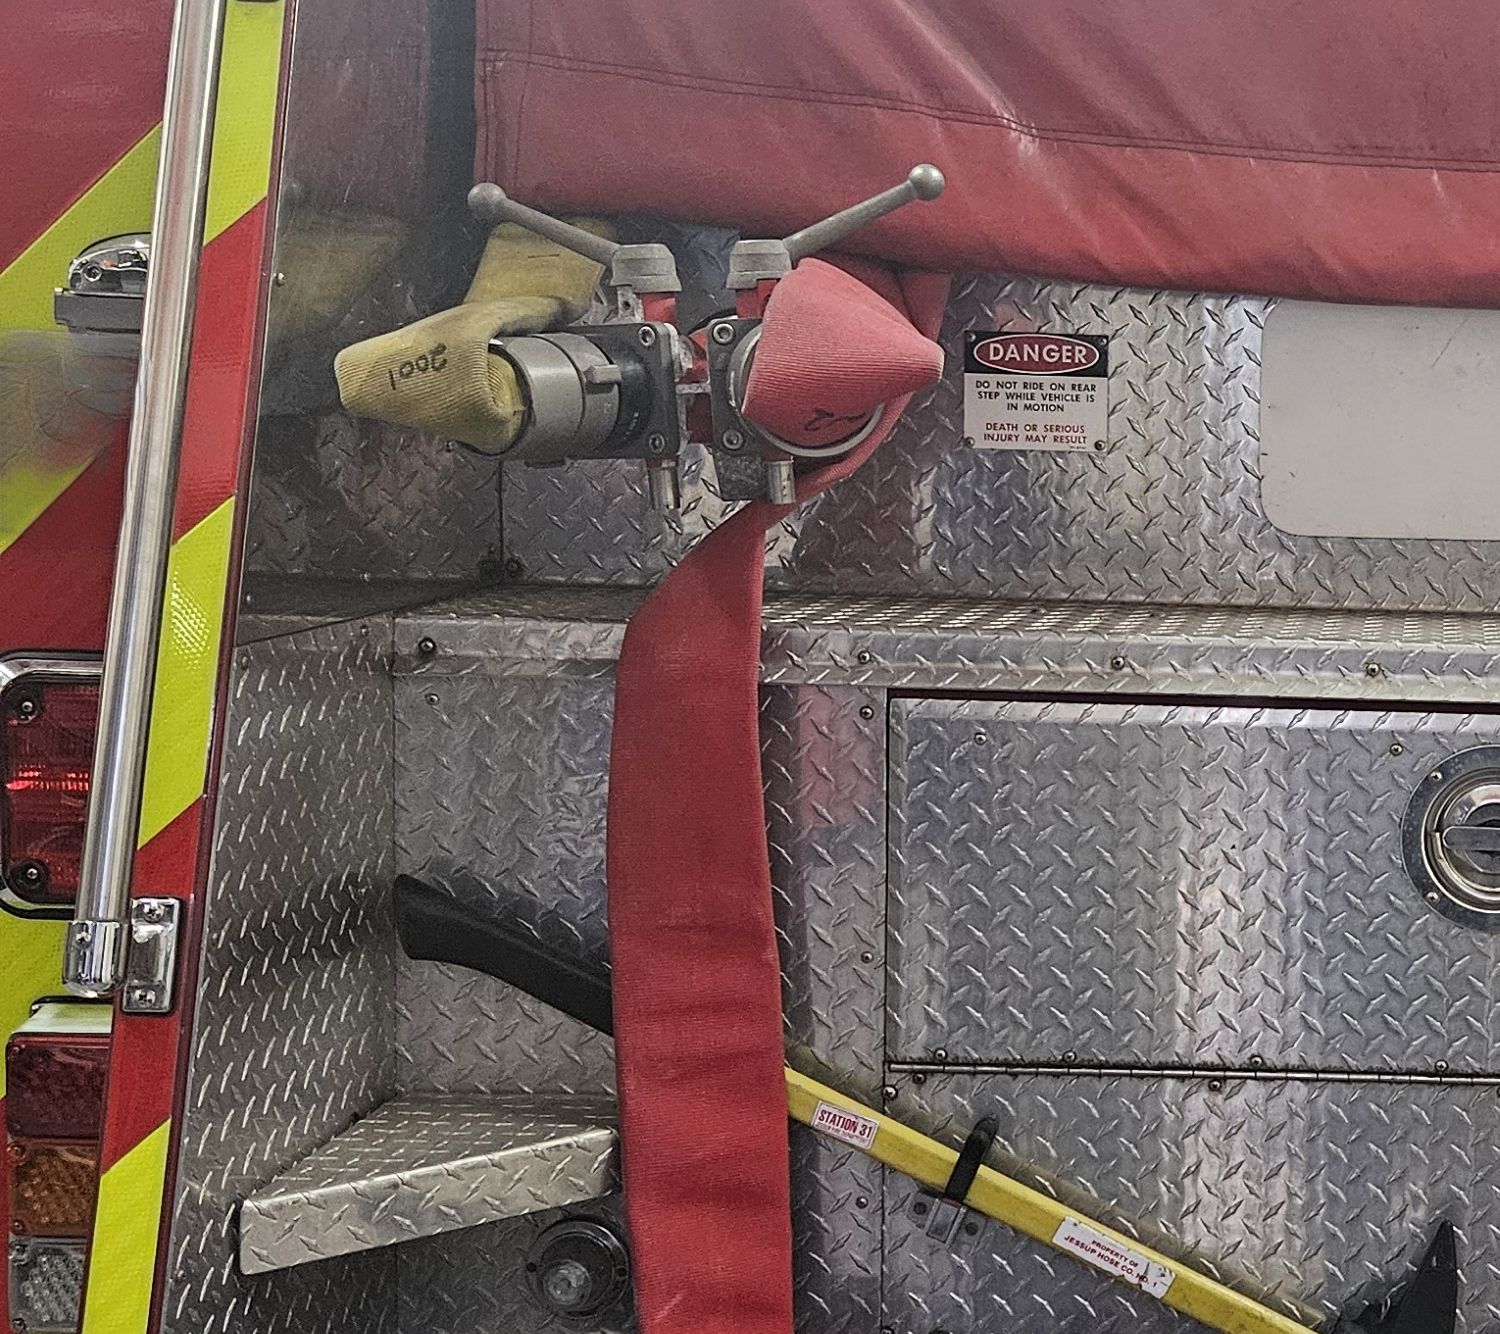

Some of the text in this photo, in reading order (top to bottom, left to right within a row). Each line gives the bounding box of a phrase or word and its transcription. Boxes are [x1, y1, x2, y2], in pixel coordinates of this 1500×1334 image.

[989, 343, 1087, 364] DANGER
[975, 380, 1097, 393] DO NOT RIDE ON REAR
[978, 391, 1095, 403] STEP WHILE VEHICLE IS
[1007, 403, 1065, 412] IN MOTION
[985, 422, 1085, 434] DEATH OR SERIOUS
[983, 433, 1087, 444] INJURY MAY RESULT
[818, 1109, 859, 1134] STATION
[859, 1124, 873, 1138] 31
[1064, 1234, 1097, 1255] JESSUP
[1097, 1251, 1119, 1267] HOSE
[1091, 1239, 1139, 1268] PROPERTY OF
